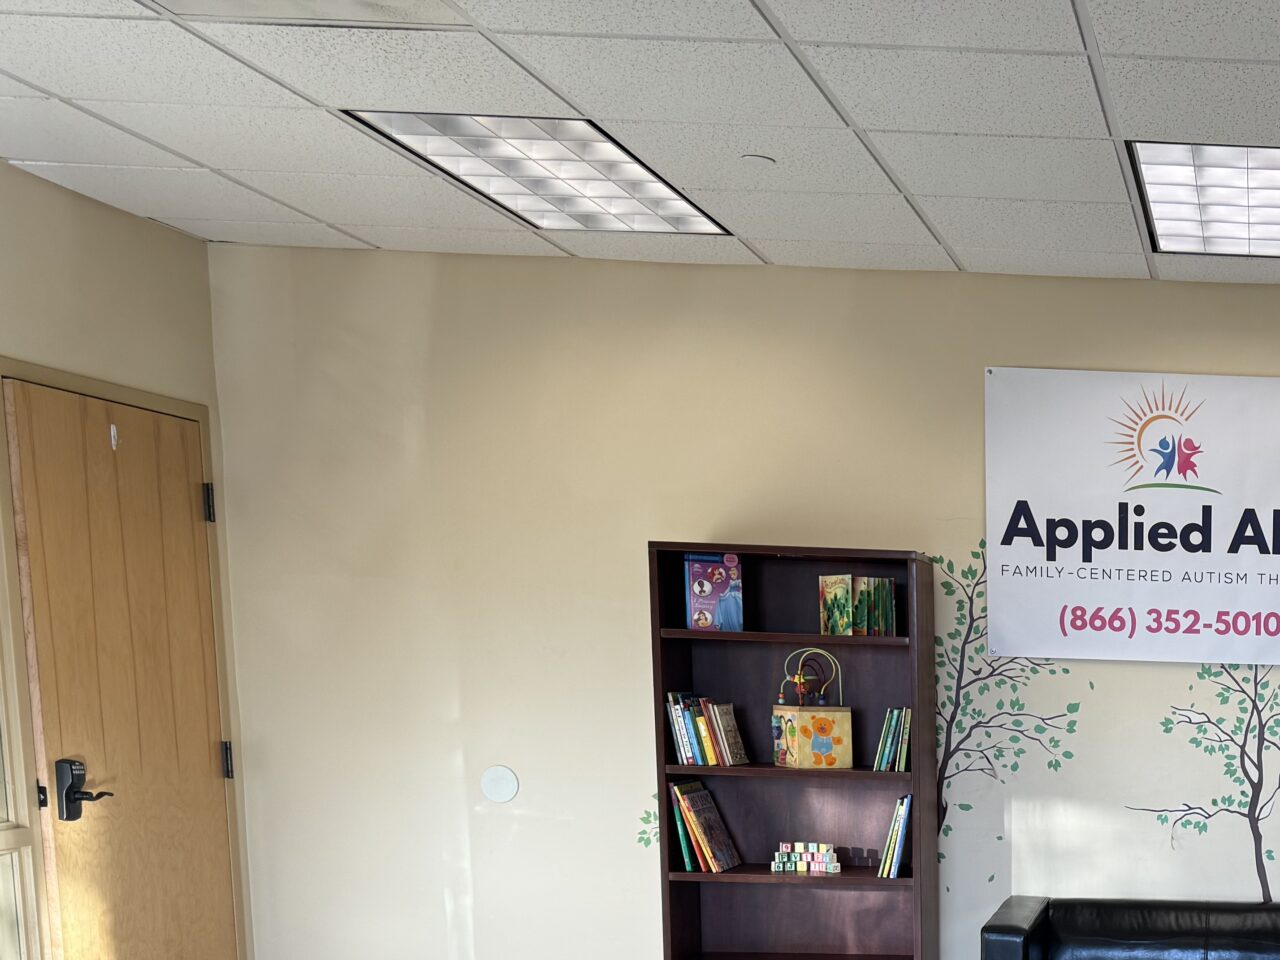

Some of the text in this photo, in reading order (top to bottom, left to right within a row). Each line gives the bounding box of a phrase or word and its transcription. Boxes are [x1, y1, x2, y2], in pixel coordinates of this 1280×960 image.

[1000, 500, 1213, 563] Applied
[1001, 564, 1173, 583] FAMILY-CENTERED
[1181, 571, 1249, 585] AUTISM
[1059, 604, 1137, 639] (866)
